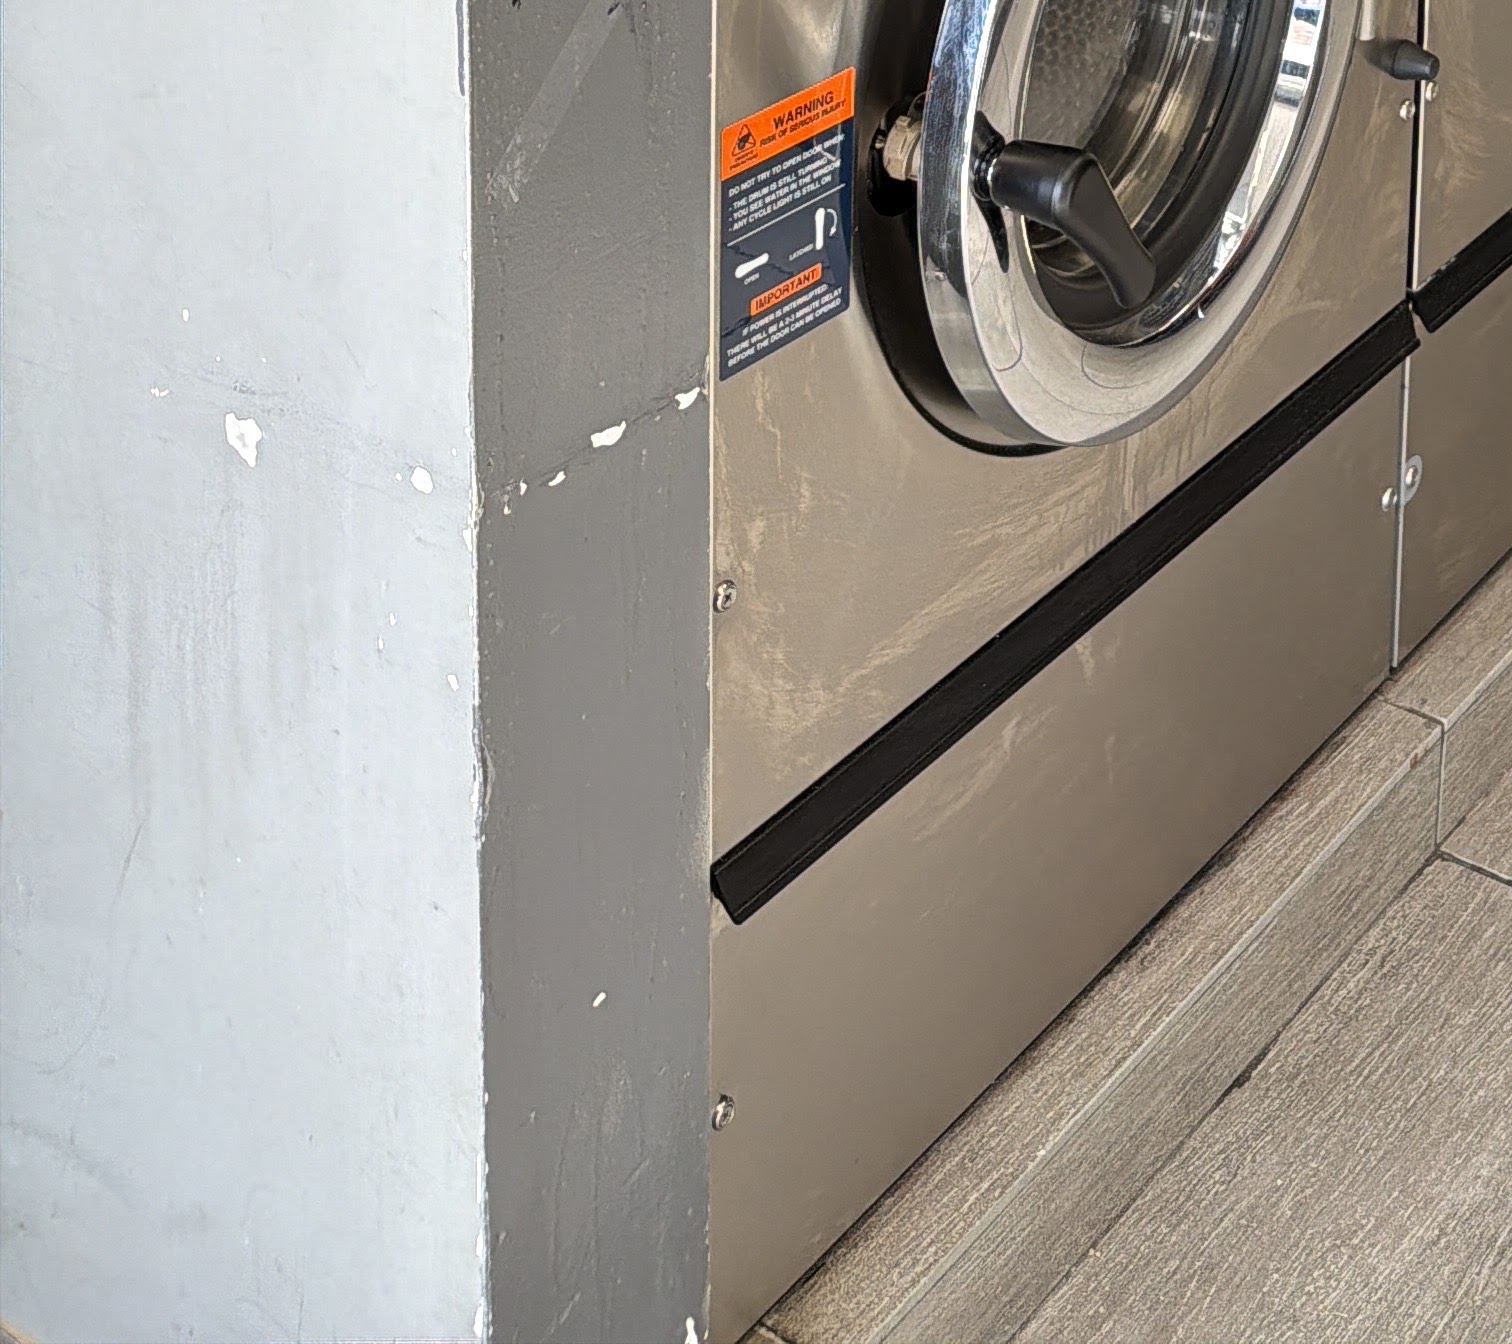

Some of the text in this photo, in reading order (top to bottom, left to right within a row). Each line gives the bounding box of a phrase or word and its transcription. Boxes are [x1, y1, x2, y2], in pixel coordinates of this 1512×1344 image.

[759, 99, 846, 147] RISK OF SERIOUS INJURY
[773, 91, 834, 130] WARNING
[729, 186, 740, 197] DO
[741, 177, 756, 191] NOT
[757, 170, 771, 183] TRY
[772, 165, 782, 175] TO
[782, 154, 801, 170] OPEN
[733, 156, 827, 209] THE DRUM IS STILL TURNING
[733, 159, 841, 220] YOU SEE WATER IN THE WINDOW
[733, 174, 832, 231] ANY CYCLE LIGHT IS STILL ON
[744, 273, 760, 285] OPEN
[755, 269, 817, 311] IMPORTANT
[727, 339, 750, 357] THERE
[751, 330, 767, 344] WILL
[768, 323, 778, 334] BE
[796, 299, 820, 319] MINUTE
[821, 286, 842, 304] DELAY
[728, 298, 841, 367] BEFORE THE DOOR CAN BE OPENED
[750, 313, 775, 332] POWER
